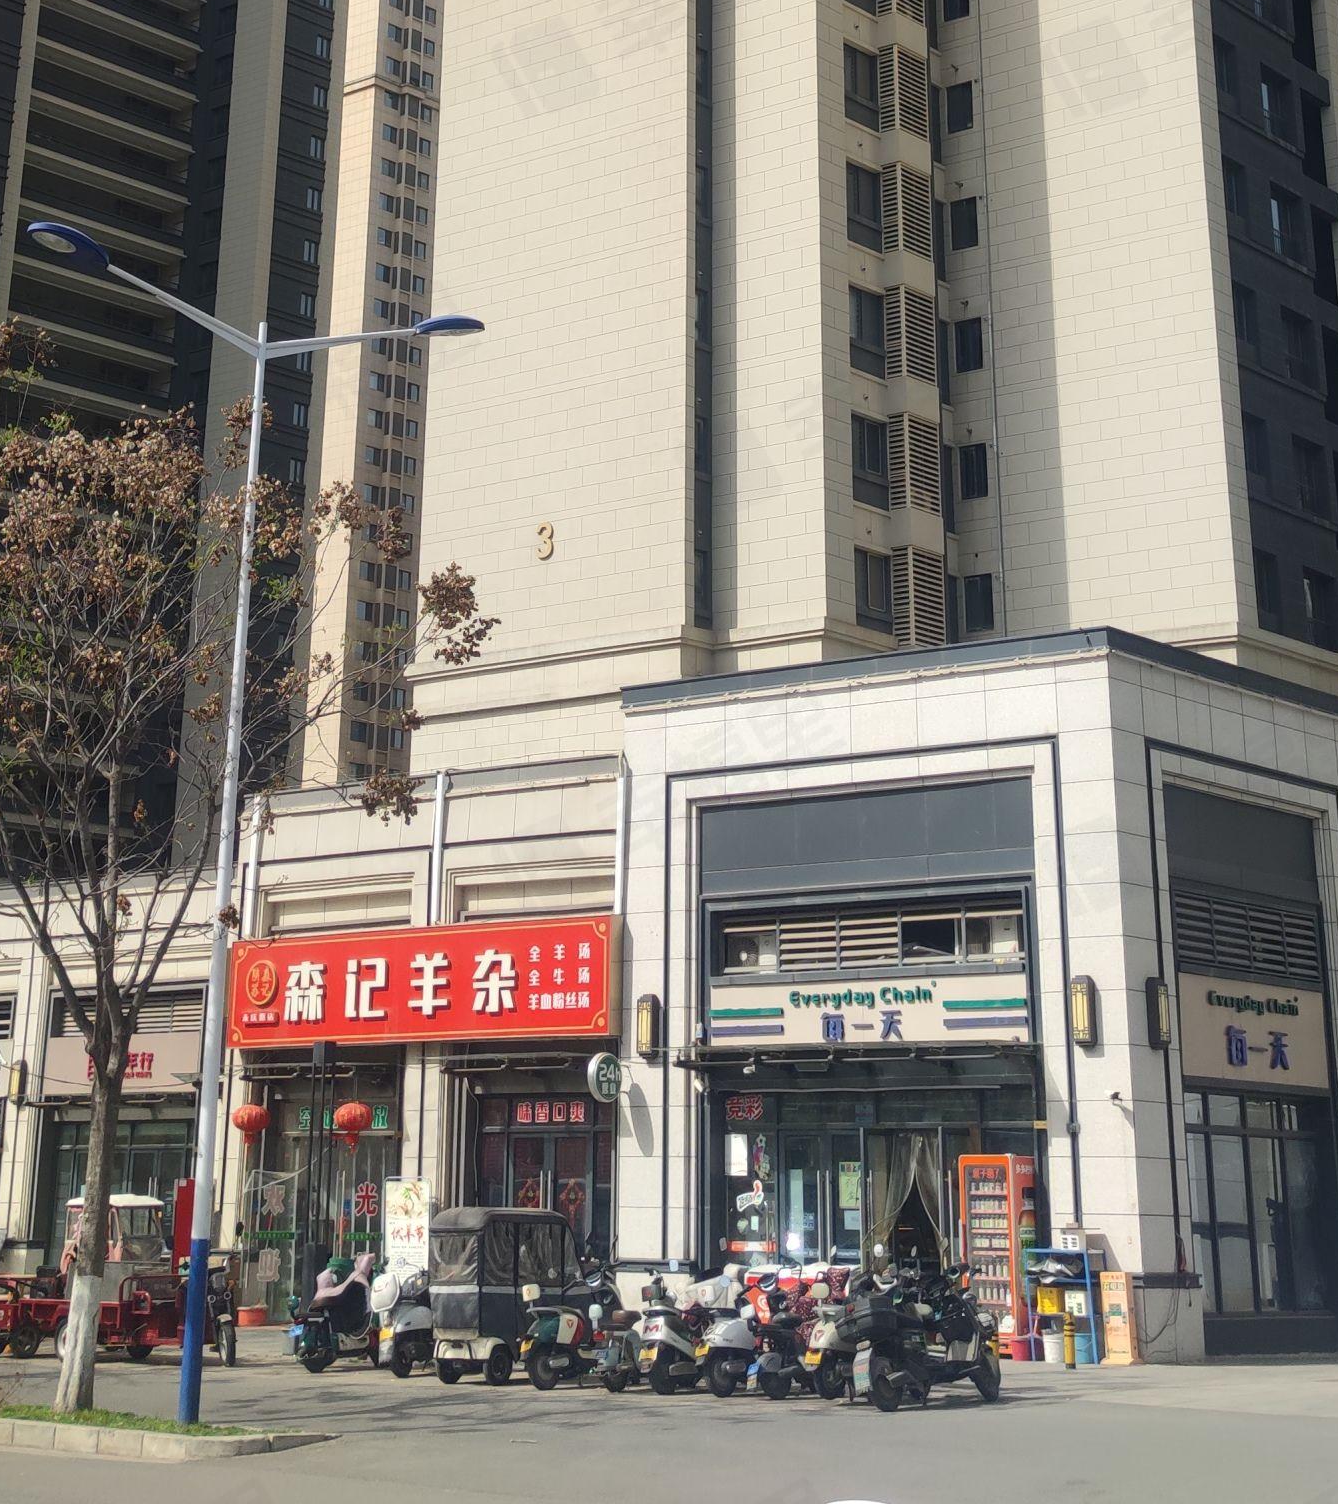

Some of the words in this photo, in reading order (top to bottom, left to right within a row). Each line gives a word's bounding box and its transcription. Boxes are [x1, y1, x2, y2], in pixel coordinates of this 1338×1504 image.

[535, 522, 554, 560] 3
[528, 942, 591, 963] 全羊汤
[284, 949, 515, 1022] 森记羊杂
[528, 967, 591, 987] 全牛汤
[528, 991, 590, 1011] 羊血粉丝汤
[789, 989, 875, 1008] Everyday
[1208, 990, 1265, 1016] Everyday
[820, 1010, 903, 1041] 每一天
[1225, 1025, 1290, 1071] 每一天
[598, 1063, 621, 1082] 24h
[299, 1105, 389, 1129] 空放
[517, 1100, 585, 1123] 味香口爽
[726, 1095, 764, 1121] 竞彩
[354, 1181, 378, 1217] 光
